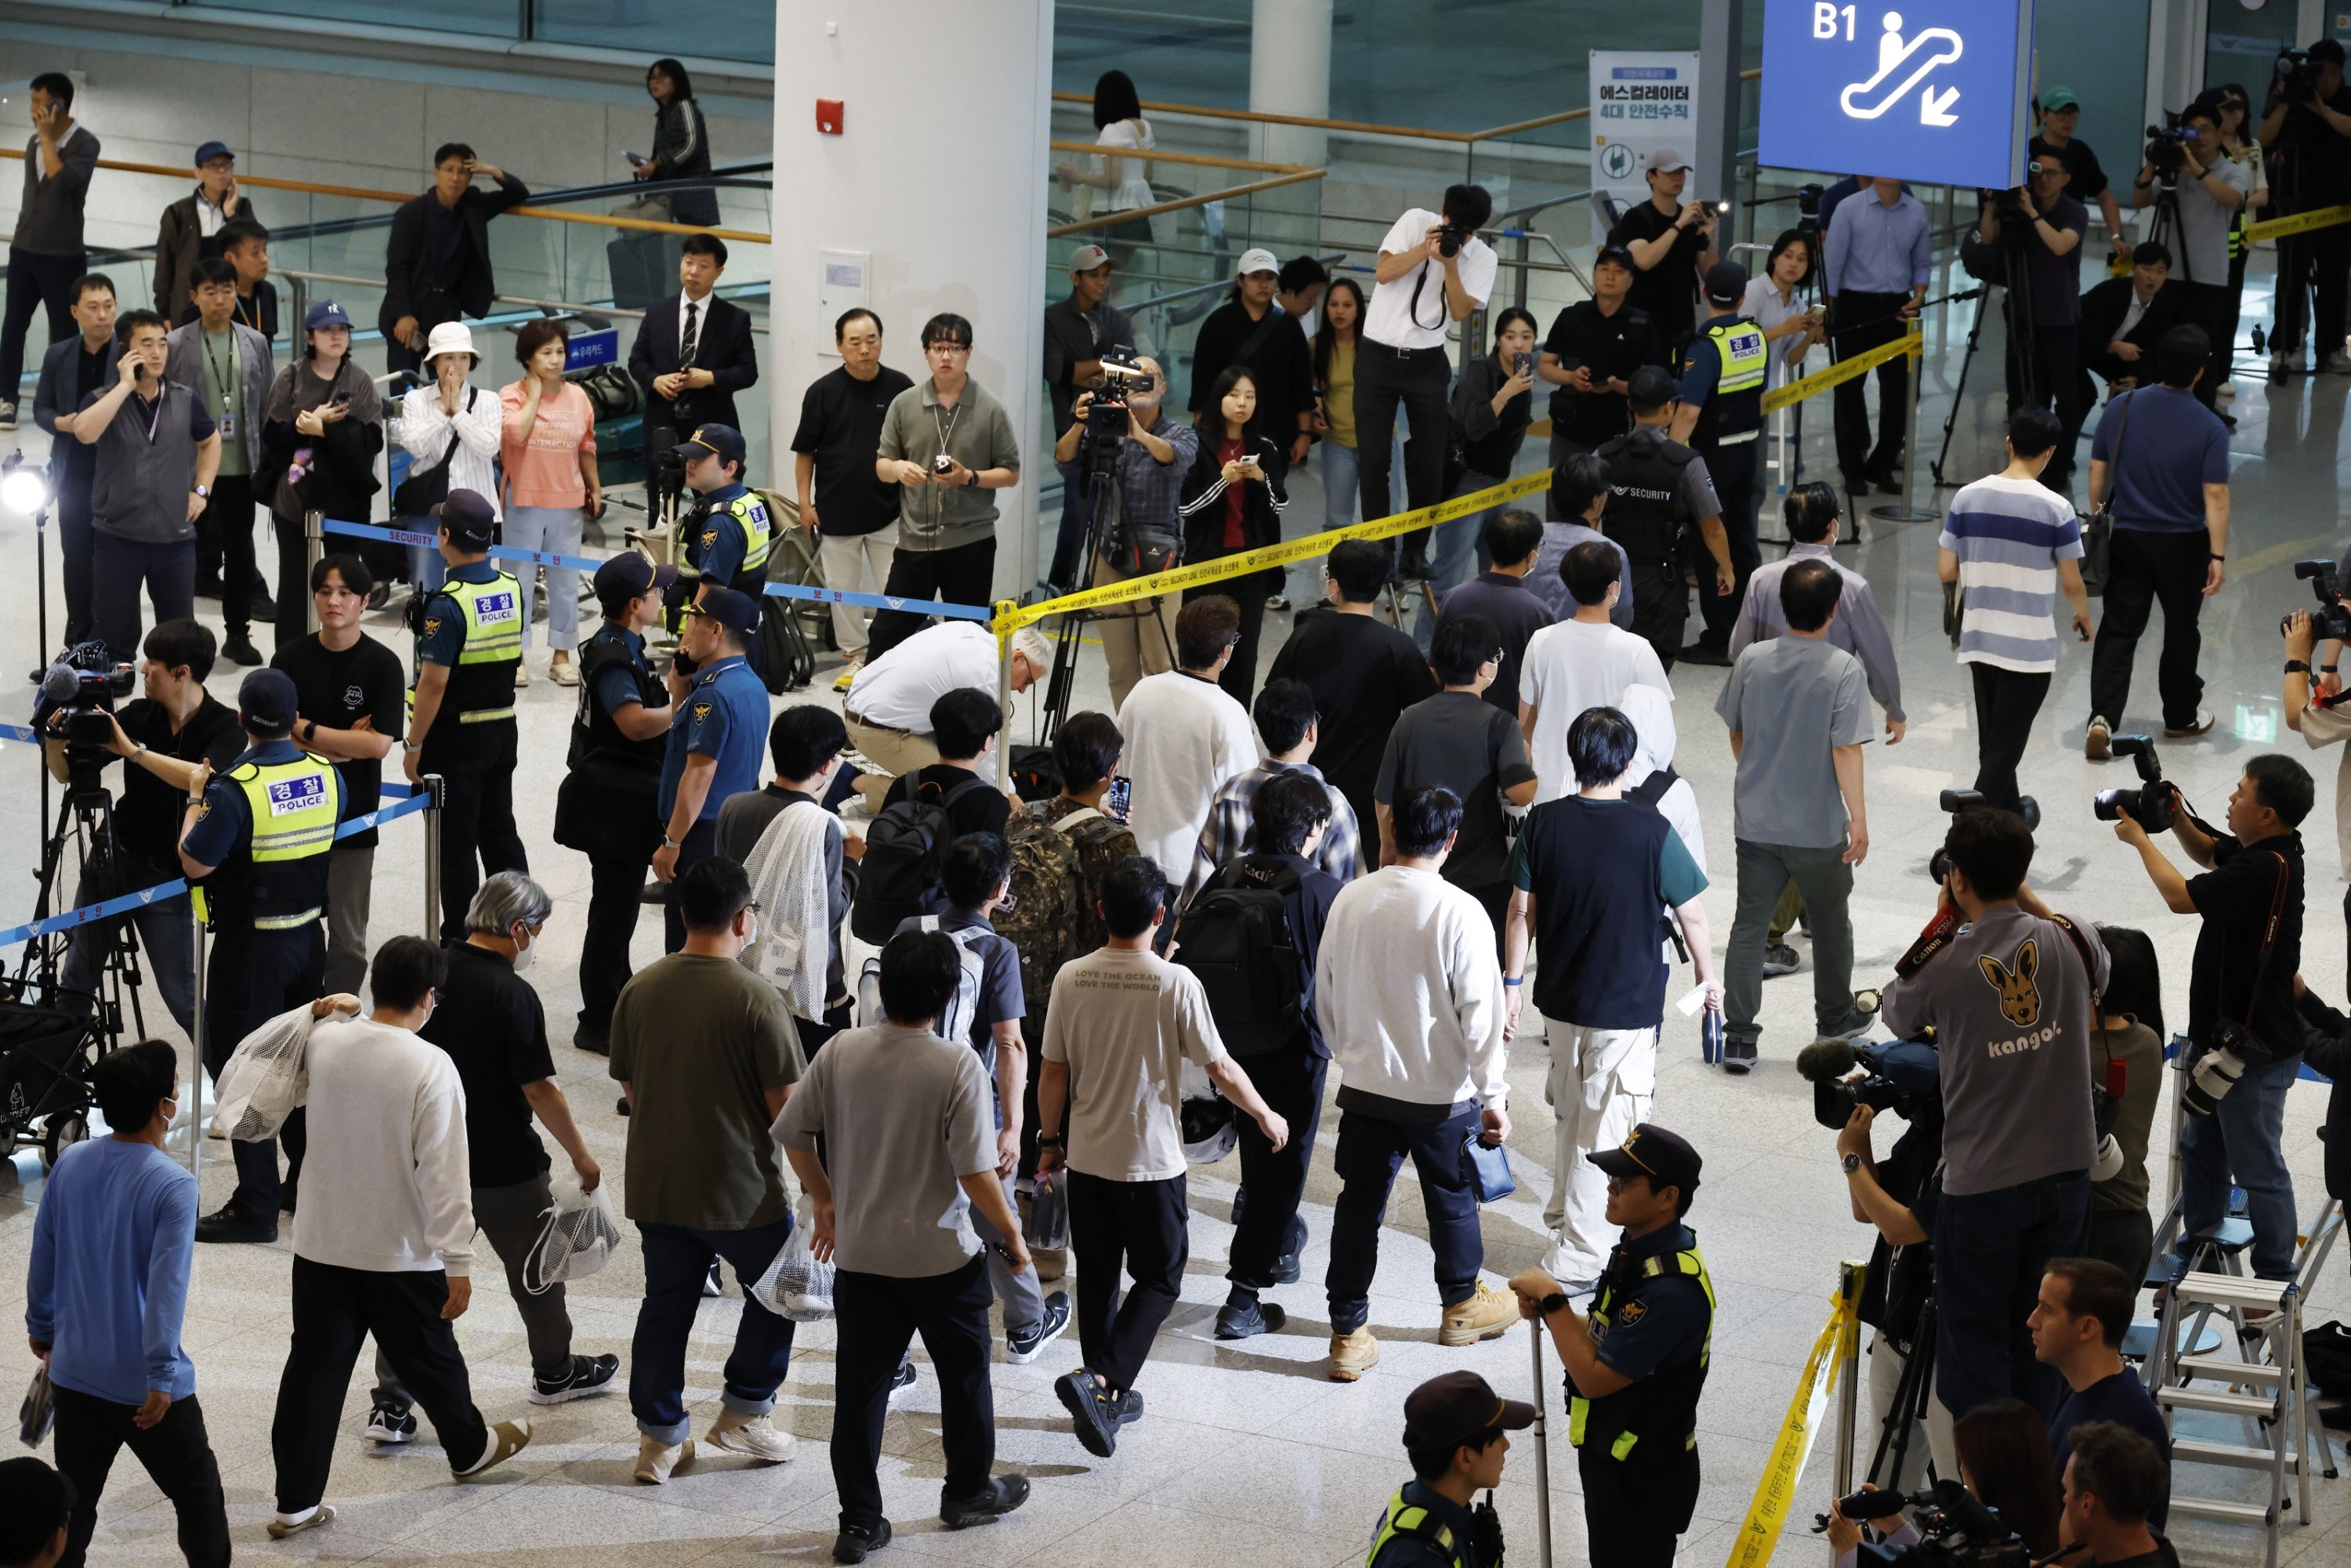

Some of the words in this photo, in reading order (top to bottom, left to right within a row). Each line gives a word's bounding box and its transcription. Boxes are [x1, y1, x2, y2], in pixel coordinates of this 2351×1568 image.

[1813, 2, 1856, 42] B1
[1600, 85, 1689, 100] 에스컬레이터
[1600, 103, 1625, 118] 4대
[1628, 103, 1688, 119] 안전수칙
[580, 344, 603, 358] 우리카드
[1734, 347, 1760, 359] POLICE
[1630, 487, 1671, 501] SECURITY
[389, 531, 433, 545] SECURITY
[1170, 574, 1189, 586] SECURITY
[1189, 570, 1198, 581] LINE
[481, 610, 512, 622] POLICE
[278, 795, 322, 813] POLICE
[1913, 938, 1942, 965] Canon
[1125, 972, 1161, 982] OCEAN
[1101, 981, 1120, 990] THE
[1123, 983, 1160, 992] WORLD
